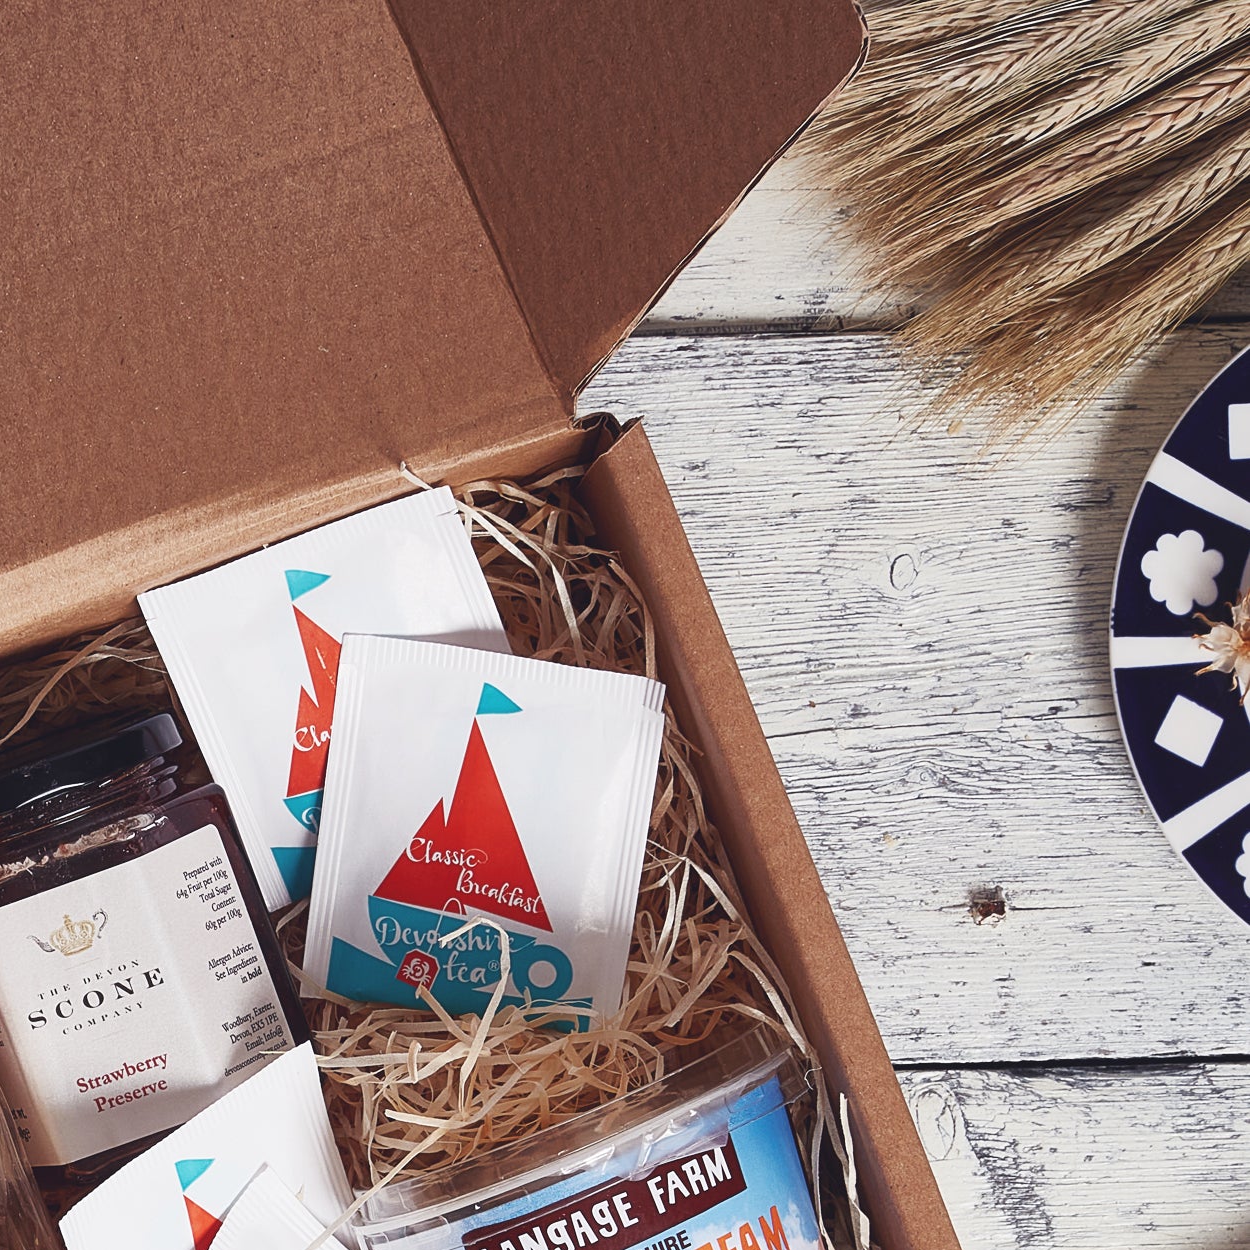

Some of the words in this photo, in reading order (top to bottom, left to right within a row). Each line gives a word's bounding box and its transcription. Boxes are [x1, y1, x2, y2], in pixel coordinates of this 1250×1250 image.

[406, 837, 488, 868] Classic
[183, 862, 209, 881] Prepared
[210, 856, 223, 868] with
[176, 888, 189, 899] 64g
[187, 881, 203, 894] Fruit
[203, 877, 213, 889] per
[213, 869, 228, 881] 100g
[199, 889, 215, 903] Total
[215, 883, 232, 895] Sugar
[456, 868, 544, 914] Breakfast
[205, 921, 217, 931] 60g
[217, 916, 227, 928] per
[227, 908, 242, 918] 100g
[208, 953, 231, 970] Allergen
[215, 972, 226, 981] See
[227, 955, 258, 975] Ingredients
[241, 974, 248, 983] in
[249, 966, 262, 981] bold
[38, 984, 71, 1000] THE
[82, 959, 140, 985] DEVON
[28, 968, 165, 1030] SCONE
[62, 1001, 143, 1035] COMPANY
[222, 1010, 252, 1032] Woodbury,
[253, 1002, 275, 1017] Exeter,
[230, 1028, 252, 1044] Devon,
[251, 1021, 265, 1033] EX5
[265, 1012, 279, 1026] 1PE
[263, 1025, 283, 1042] Info@
[76, 1053, 168, 1093] Strawberry
[94, 1079, 168, 1112] Preserve
[646, 1146, 732, 1215] FARM
